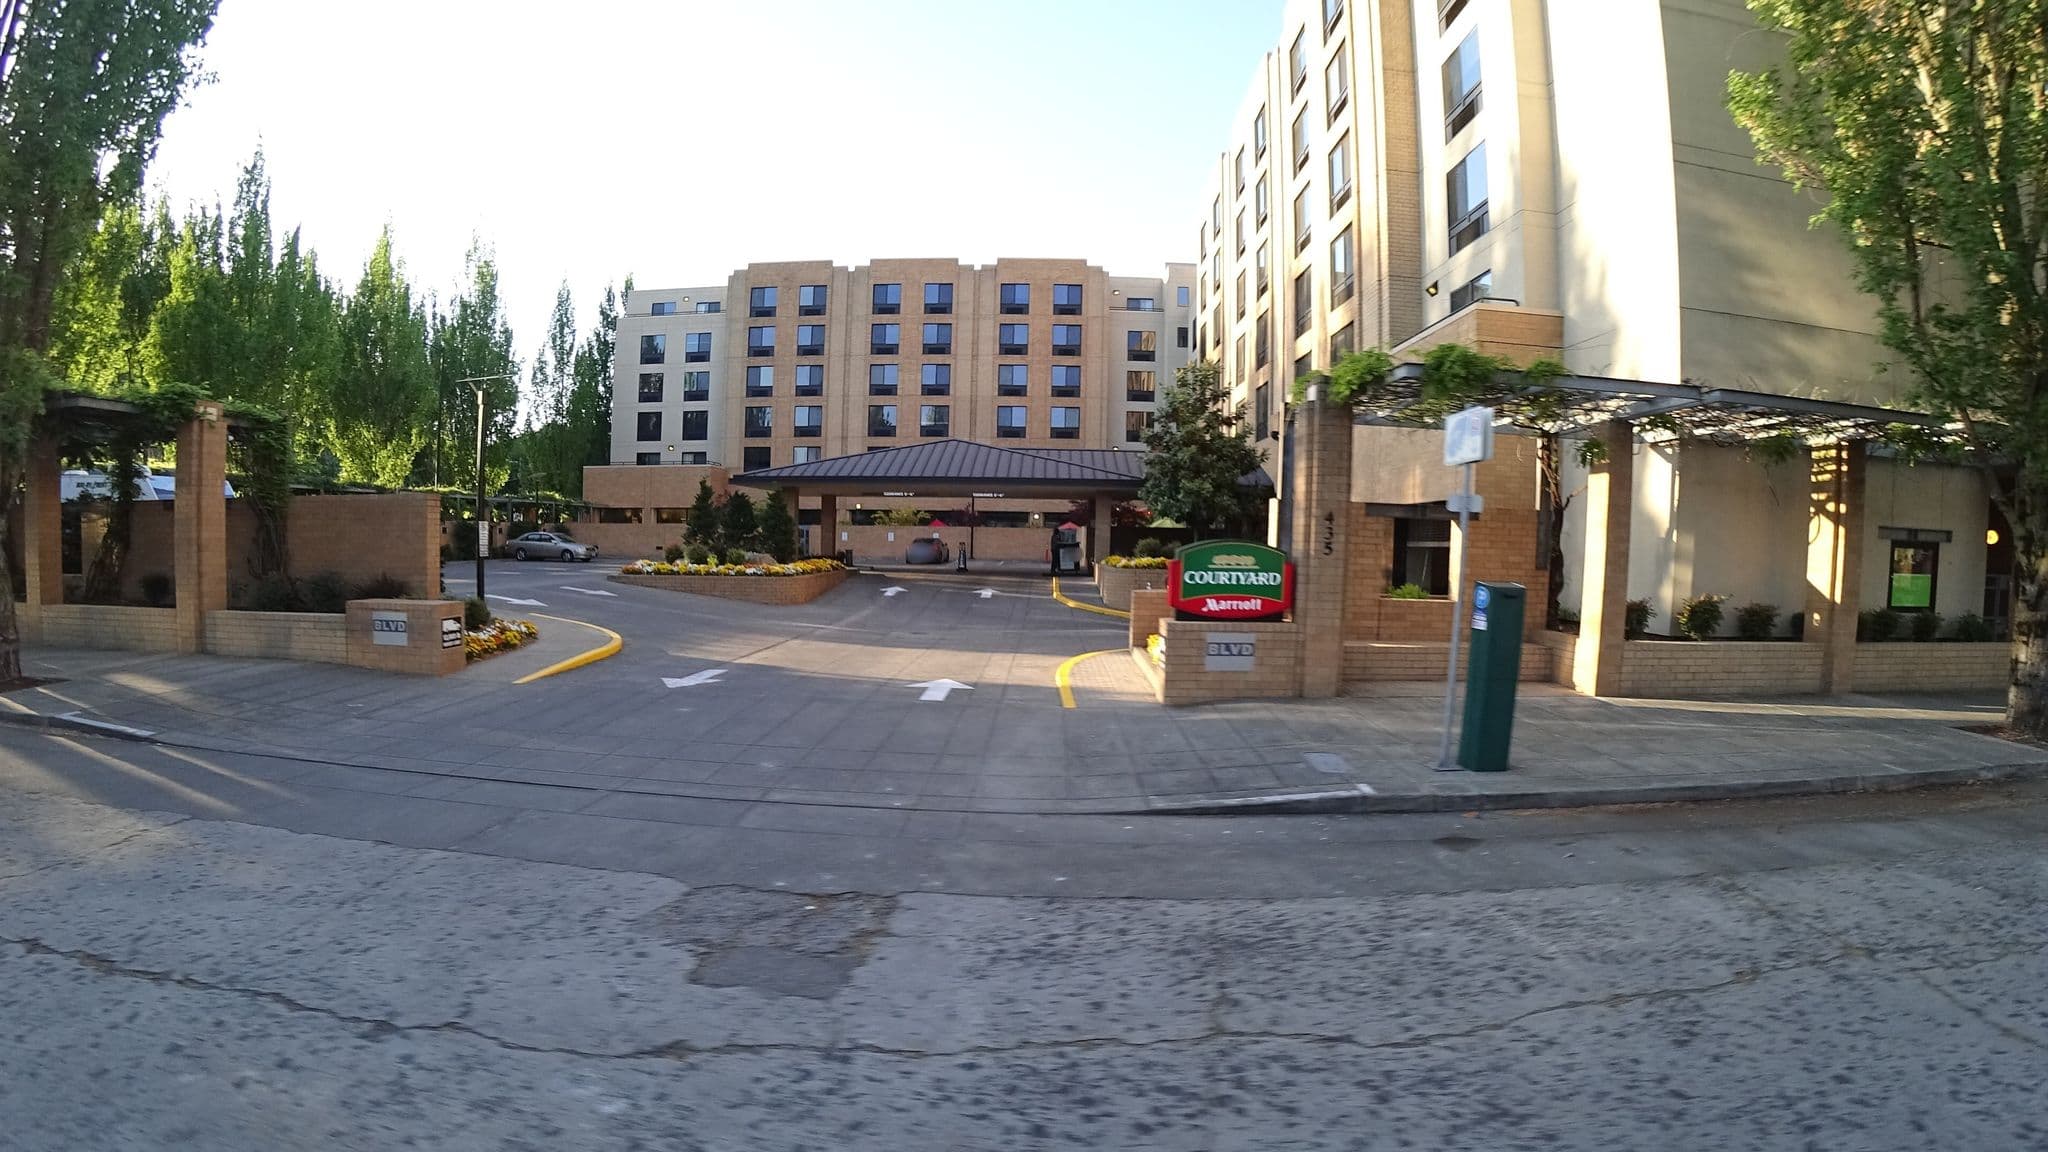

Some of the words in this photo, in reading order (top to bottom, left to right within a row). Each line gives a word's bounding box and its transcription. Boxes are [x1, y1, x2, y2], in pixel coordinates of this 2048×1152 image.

[1323, 511, 1335, 556] 435
[1184, 570, 1282, 586] COURTYARD
[1202, 598, 1262, 611] Marriott
[374, 620, 406, 631] BLVD
[1208, 643, 1254, 656] BLVD
